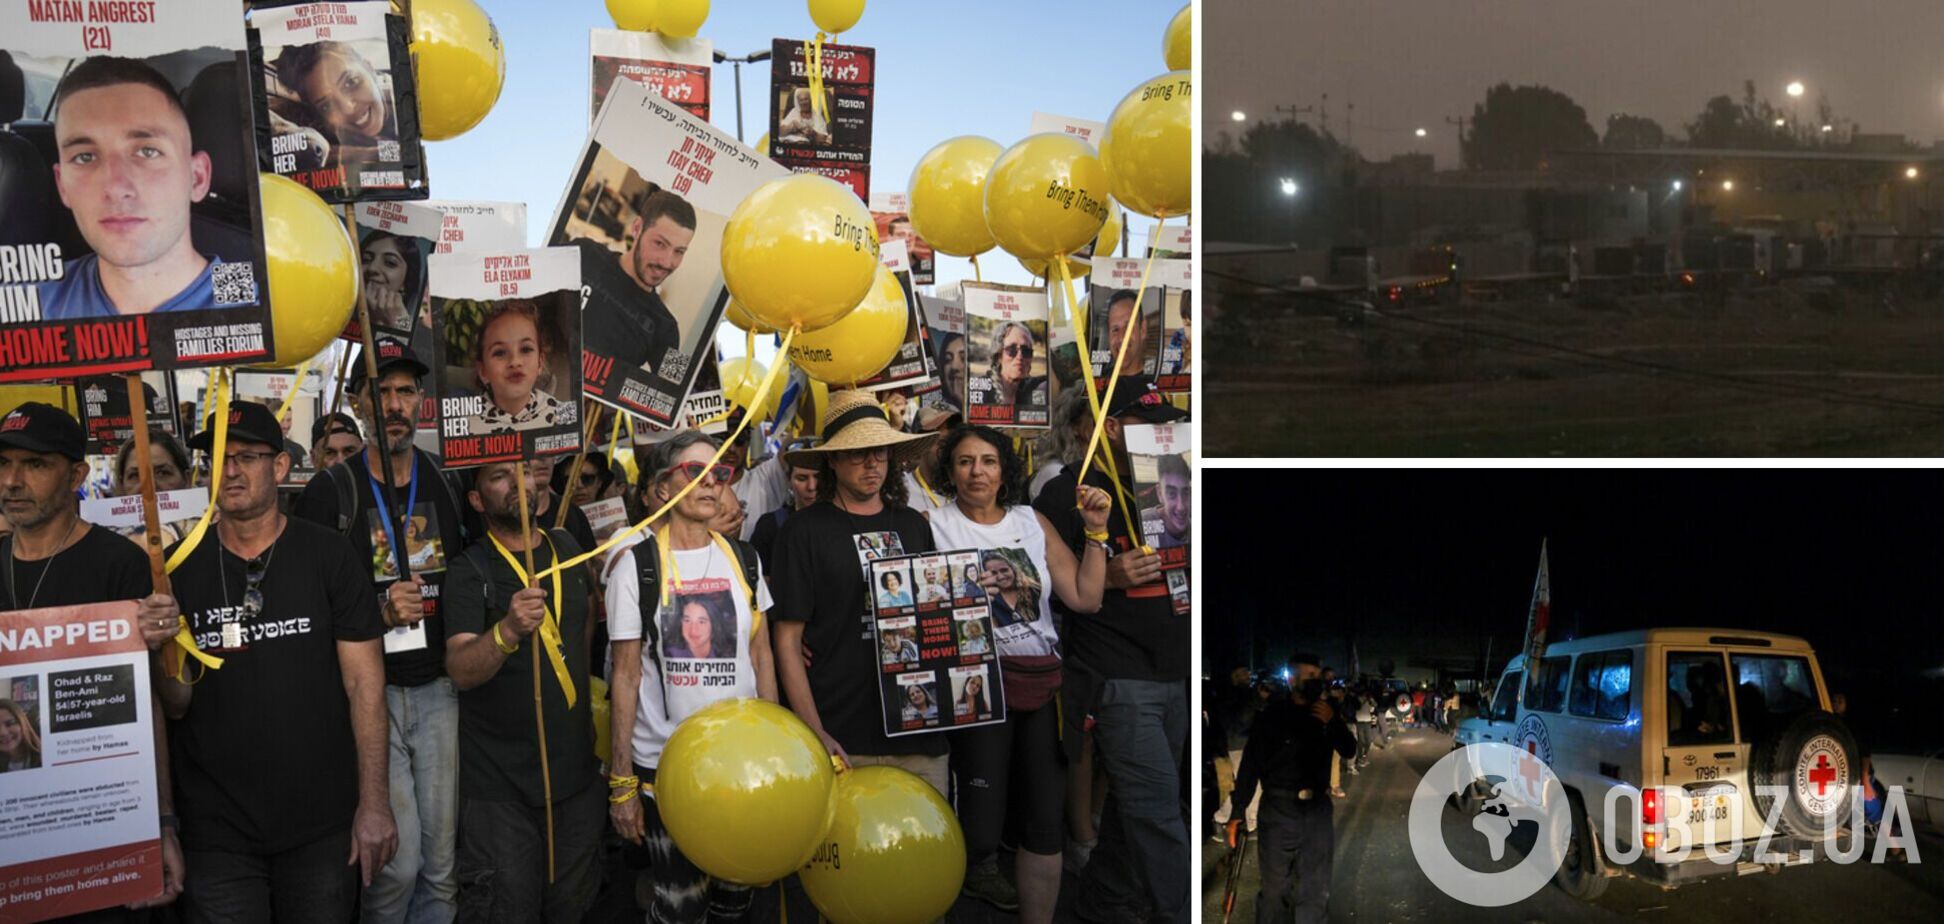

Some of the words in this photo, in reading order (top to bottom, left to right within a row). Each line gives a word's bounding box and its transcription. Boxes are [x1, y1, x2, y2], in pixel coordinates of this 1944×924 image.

[28, 0, 83, 22] MATAN
[89, 0, 155, 23] ANGREST
[286, 17, 311, 31] MORAN
[312, 15, 335, 26] STELA
[82, 25, 111, 51] (21)
[1142, 85, 1174, 101] Bring
[675, 119, 711, 142] הביתה,
[272, 133, 308, 155] BRING
[680, 136, 696, 153] חן
[713, 135, 738, 157] לחזור
[694, 139, 717, 167] איתי
[738, 150, 759, 170] חייב
[273, 154, 297, 173] HER
[666, 150, 688, 171] ITAY
[687, 161, 714, 185] CHEN
[311, 168, 347, 189] NOW!
[672, 173, 693, 196] (19)
[1047, 180, 1075, 210] Bring
[1074, 188, 1098, 216] Them
[443, 230, 464, 242] CHEN
[834, 214, 863, 252] Bring
[0, 242, 64, 283] RING
[484, 256, 513, 269] אליקים
[514, 255, 530, 268] אלה
[484, 270, 499, 283] ELA
[500, 269, 531, 283] ELYAKIM
[500, 283, 518, 297] (8.5)
[74, 315, 150, 361] NOW!
[174, 326, 213, 340] HOSTAGES
[213, 325, 228, 337] AND
[229, 322, 262, 336] MISSING
[176, 338, 225, 358] FAMILIES
[225, 334, 264, 353] FORUM
[801, 345, 832, 362] Home
[970, 391, 984, 404] HER
[442, 396, 482, 417] BRING
[443, 417, 470, 437] HER
[444, 436, 482, 458] HOME
[484, 431, 523, 454] NOW!
[111, 504, 136, 516] MORAN
[160, 501, 179, 511] YANAI
[194, 612, 200, 628] I
[922, 617, 949, 628] BRING
[195, 626, 249, 650] YOR
[250, 617, 311, 641] VOICE
[923, 635, 950, 644] HOME
[924, 627, 950, 636] THEM
[921, 646, 958, 659] NOW!
[694, 662, 736, 673] מחזירים
[54, 677, 82, 687] Ohad
[84, 675, 92, 684] &
[94, 673, 113, 683] Raz
[703, 675, 736, 687] הביתה
[55, 686, 99, 699] Ben-Ami
[55, 711, 93, 722] Israelis
[103, 741, 129, 749] Hamas
[1810, 738, 1848, 790] INTERNATIONAL
[1695, 766, 1720, 781] 17961
[95, 780, 124, 791] abducted
[33, 811, 45, 819] and
[22, 874, 43, 886] this
[46, 866, 81, 883] poster
[83, 864, 105, 876] and
[10, 888, 42, 904] bring
[44, 882, 75, 897] them
[77, 874, 110, 890] home
[111, 871, 142, 884] alive.
